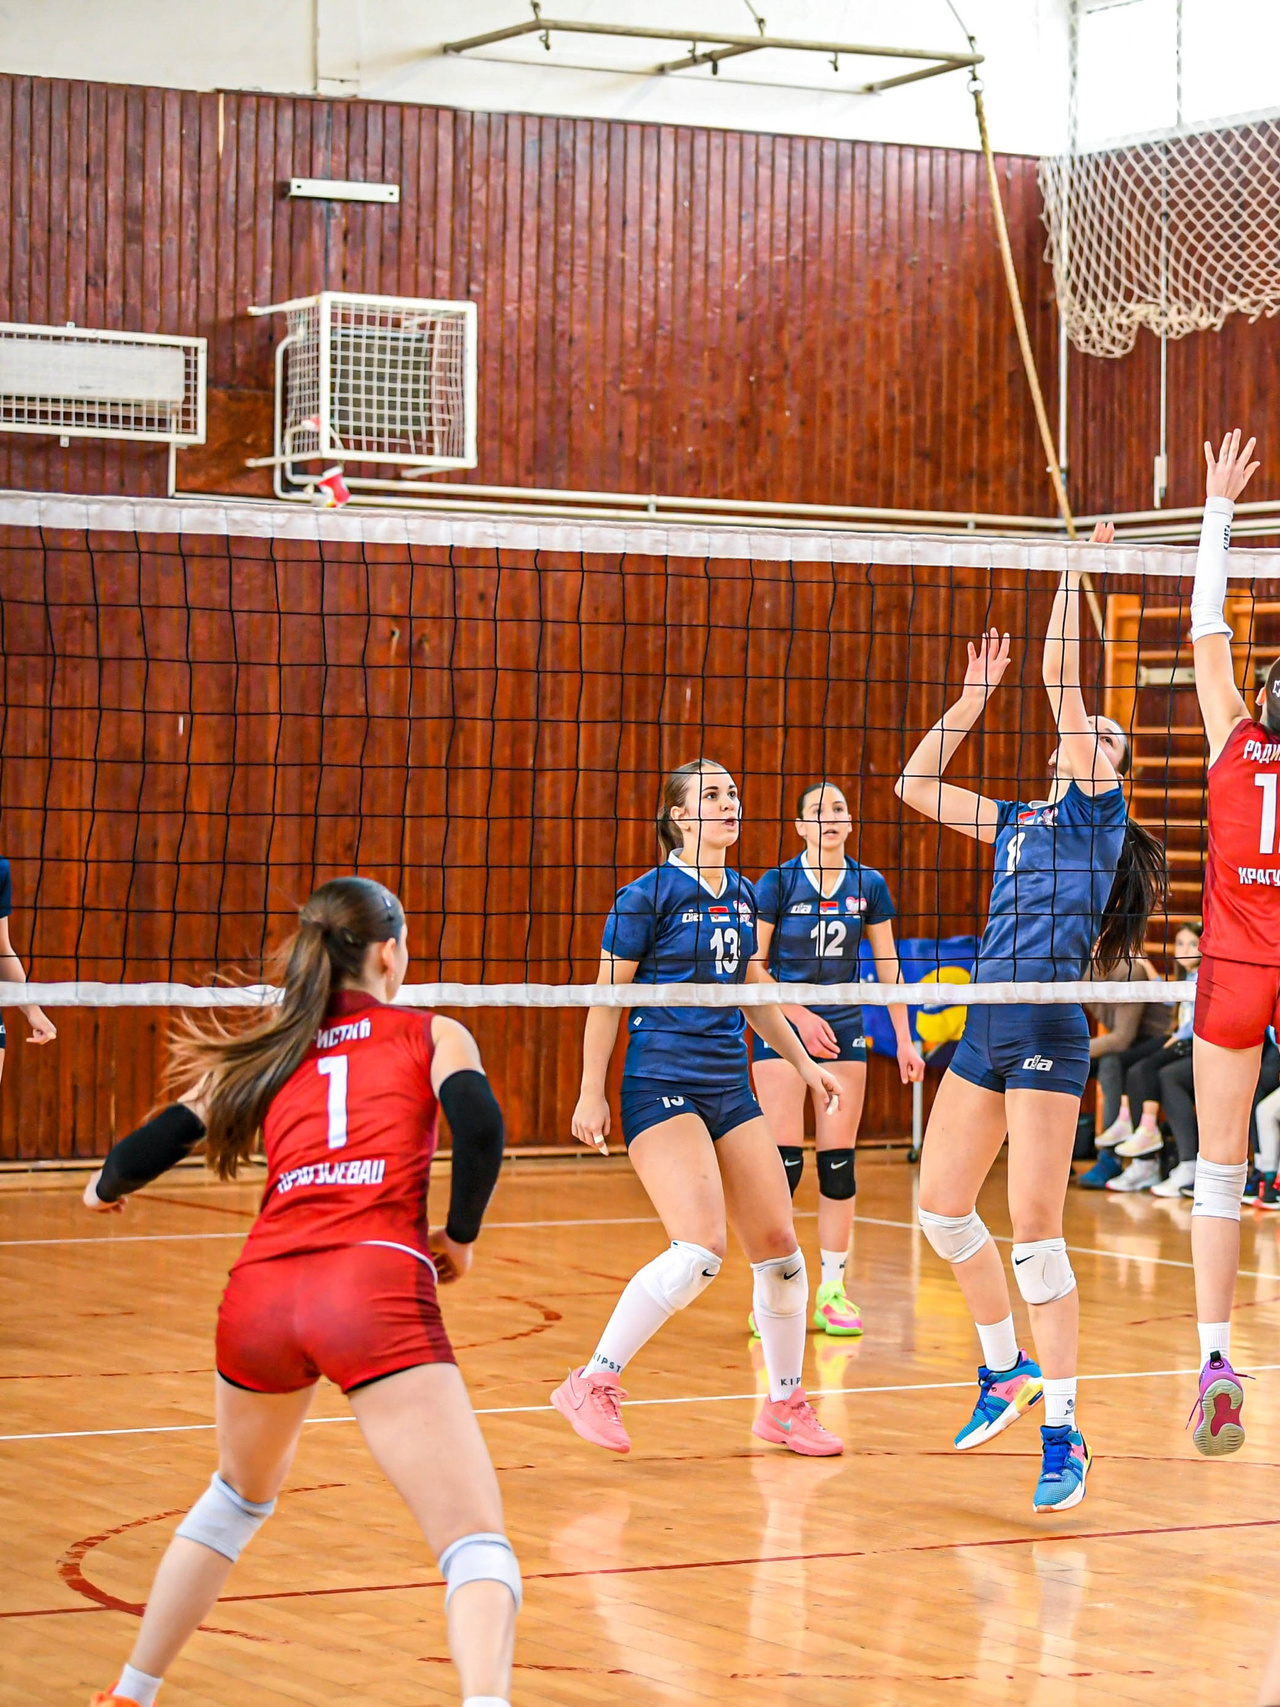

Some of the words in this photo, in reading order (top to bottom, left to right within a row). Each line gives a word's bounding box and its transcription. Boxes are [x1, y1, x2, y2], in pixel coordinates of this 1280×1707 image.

[710, 928, 740, 975] 13
[810, 920, 847, 957] 12
[316, 1017, 372, 1049] ИСТИЋ
[317, 1054, 348, 1150] 1
[593, 1352, 622, 1374] KIPST
